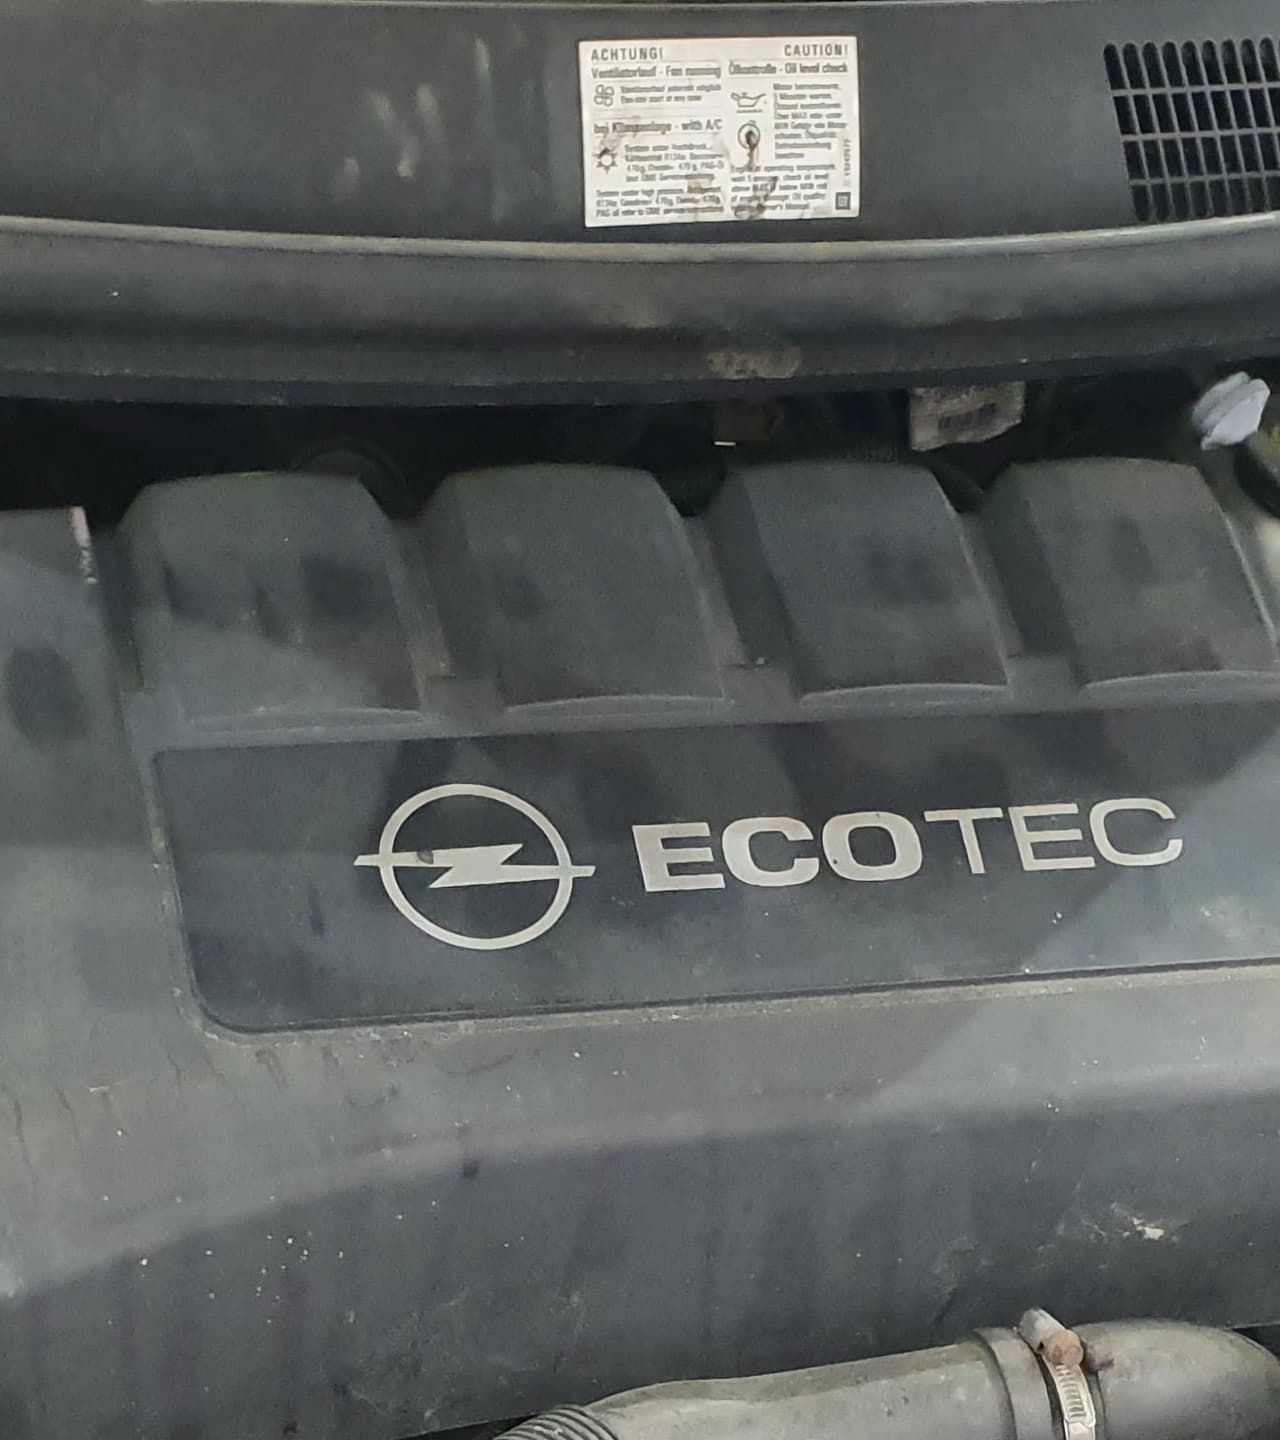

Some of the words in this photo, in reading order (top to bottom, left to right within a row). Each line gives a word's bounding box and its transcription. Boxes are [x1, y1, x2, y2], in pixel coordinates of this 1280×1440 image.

[591, 47, 663, 60] ACHTUNG!
[784, 44, 848, 56] CAUTION!
[631, 798, 1183, 892] ECOTEC
